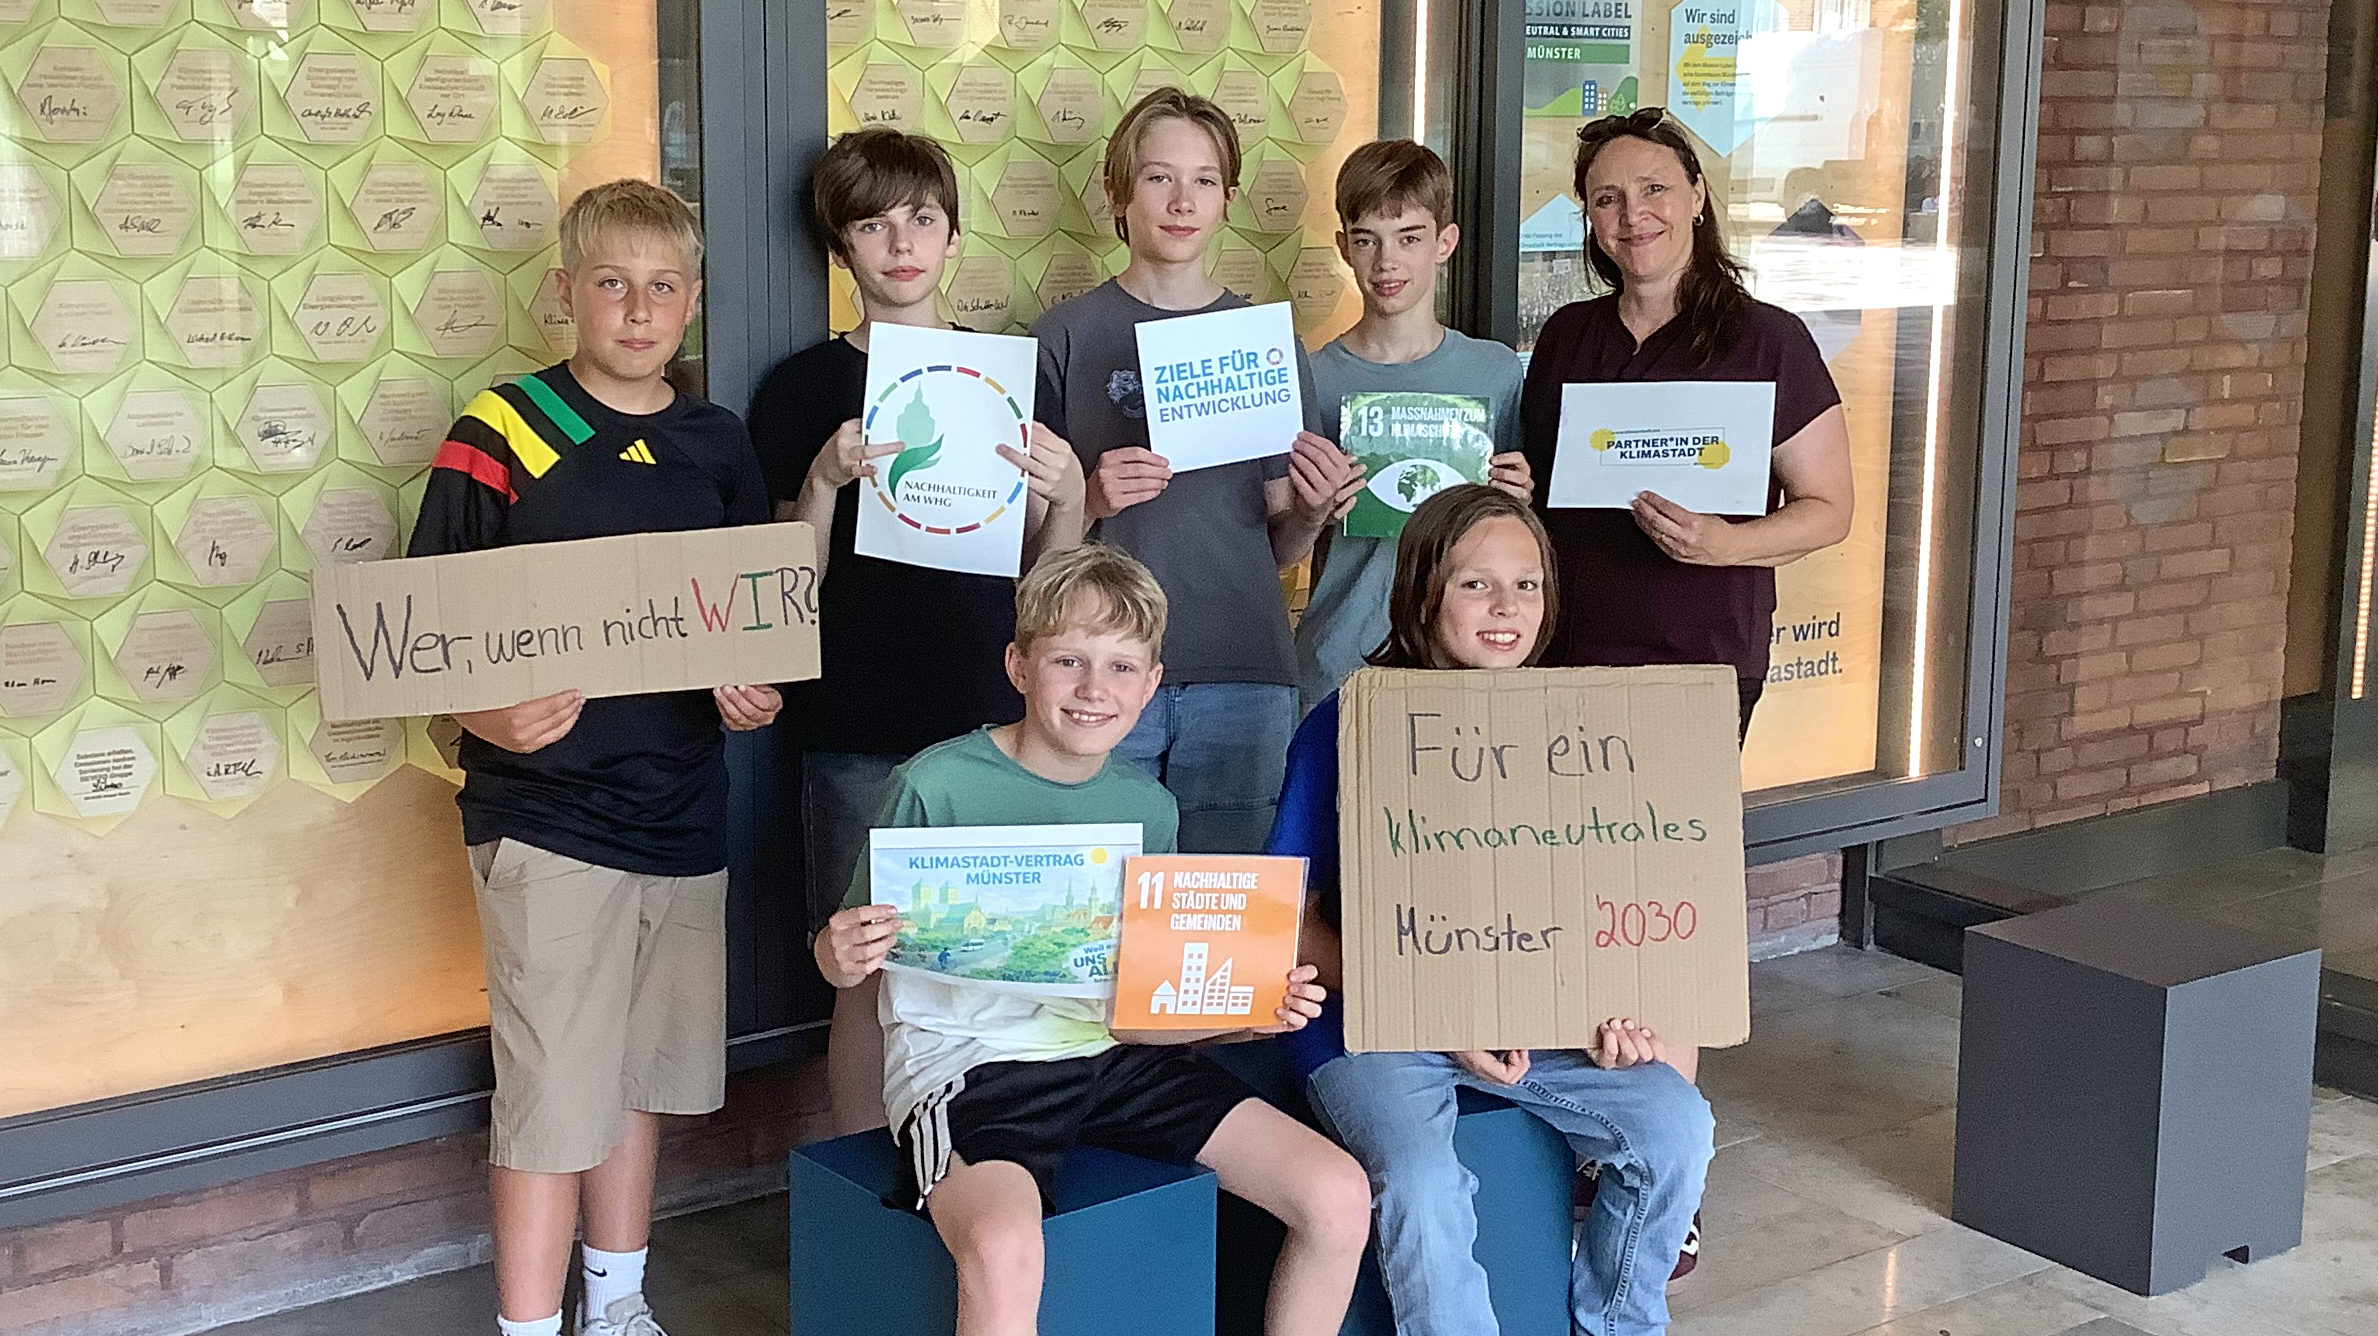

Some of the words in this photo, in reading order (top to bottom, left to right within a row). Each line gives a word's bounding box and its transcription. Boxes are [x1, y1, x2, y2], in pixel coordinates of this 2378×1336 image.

[1581, 2, 1632, 19] LABEL
[1685, 8, 1707, 23] Wir
[1709, 9, 1735, 24] sind
[1526, 26, 1560, 36] EUTRAL
[1562, 26, 1569, 36] &
[1570, 27, 1600, 37] SMART
[1602, 27, 1629, 38] CITIES
[1527, 45, 1581, 59] MÜNSTER
[1154, 358, 1214, 385] ZIELE
[1218, 349, 1259, 374] FÜR
[1156, 367, 1289, 404] NACHHALTIGE
[1159, 388, 1291, 423] ENTWICKLUNG
[1391, 406, 1462, 420] MASSNAHMEN
[1463, 408, 1486, 422] ZUM
[1357, 405, 1384, 437] 13
[1692, 436, 1719, 446] DER
[1619, 447, 1705, 459] KLIMASTADT
[904, 481, 997, 499] NACHHALTIGKEIT
[903, 493, 921, 504] AM
[922, 495, 952, 508] WHG
[336, 595, 473, 681] Wer,
[484, 624, 582, 664] wenn
[603, 596, 687, 647] nicht
[691, 567, 818, 633] WIR?
[1792, 612, 1840, 642] wird
[1766, 650, 1843, 683] astadt.
[1408, 713, 1518, 782] Für
[1547, 725, 1635, 777] ein
[908, 854, 1085, 869] KLIMASTADT-VERTRAG
[966, 870, 1042, 885] MÜNSTER
[1137, 871, 1165, 909] 11
[1173, 871, 1259, 889] NACHHALTIGE
[1171, 890, 1219, 910] STÄDTE
[1220, 893, 1247, 910] UND
[1170, 914, 1242, 931] GEMEINDEN
[1395, 903, 1563, 956] Münster
[1595, 898, 1698, 948] 2030
[1073, 953, 1107, 967] UNS
